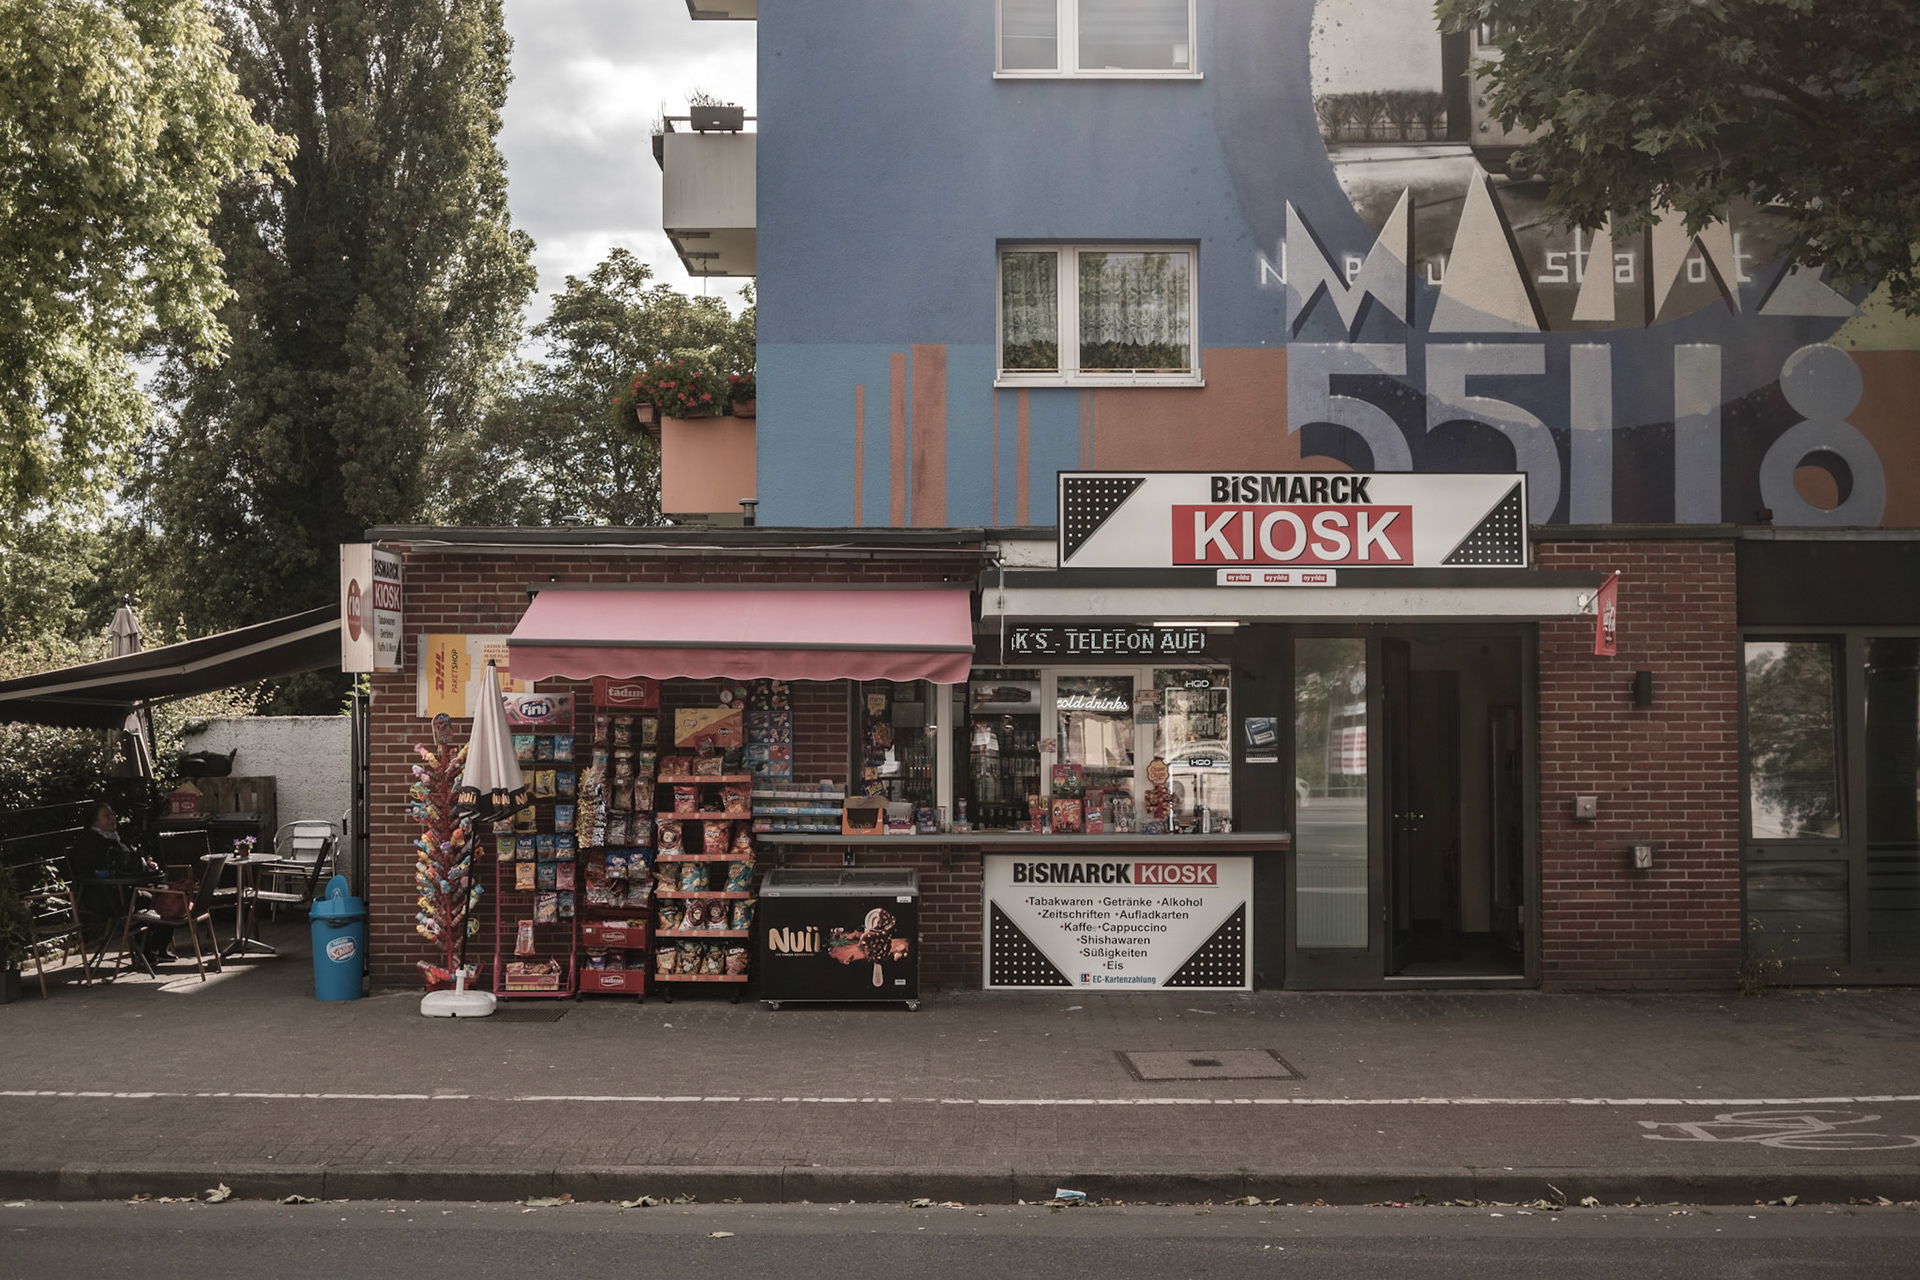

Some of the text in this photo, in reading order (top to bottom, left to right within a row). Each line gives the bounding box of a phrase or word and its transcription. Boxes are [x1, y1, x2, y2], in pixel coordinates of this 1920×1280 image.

[1288, 342, 1886, 527] 55118
[1194, 510, 1402, 561] KIOSK
[375, 583, 400, 610] KIOSK
[1066, 633, 1154, 649] TELEFON
[436, 651, 444, 692] DHL
[1186, 680, 1210, 688] HQD
[522, 702, 547, 716] Fini
[1085, 696, 1128, 710] drinks
[1141, 865, 1214, 883] KIOSK
[1029, 897, 1203, 906] Tabakwaren Getränke Alkohol
[1042, 910, 1189, 920] Zeitschriften Aufladkarten
[1102, 922, 1167, 934] Cappuccino
[768, 926, 820, 953] Nuii
[1080, 935, 1150, 945] Shishawaren
[1083, 948, 1148, 959] Süßigkeiten
[1107, 960, 1124, 970] Eis
[1093, 975, 1156, 985] EC-Kartenzahlung
